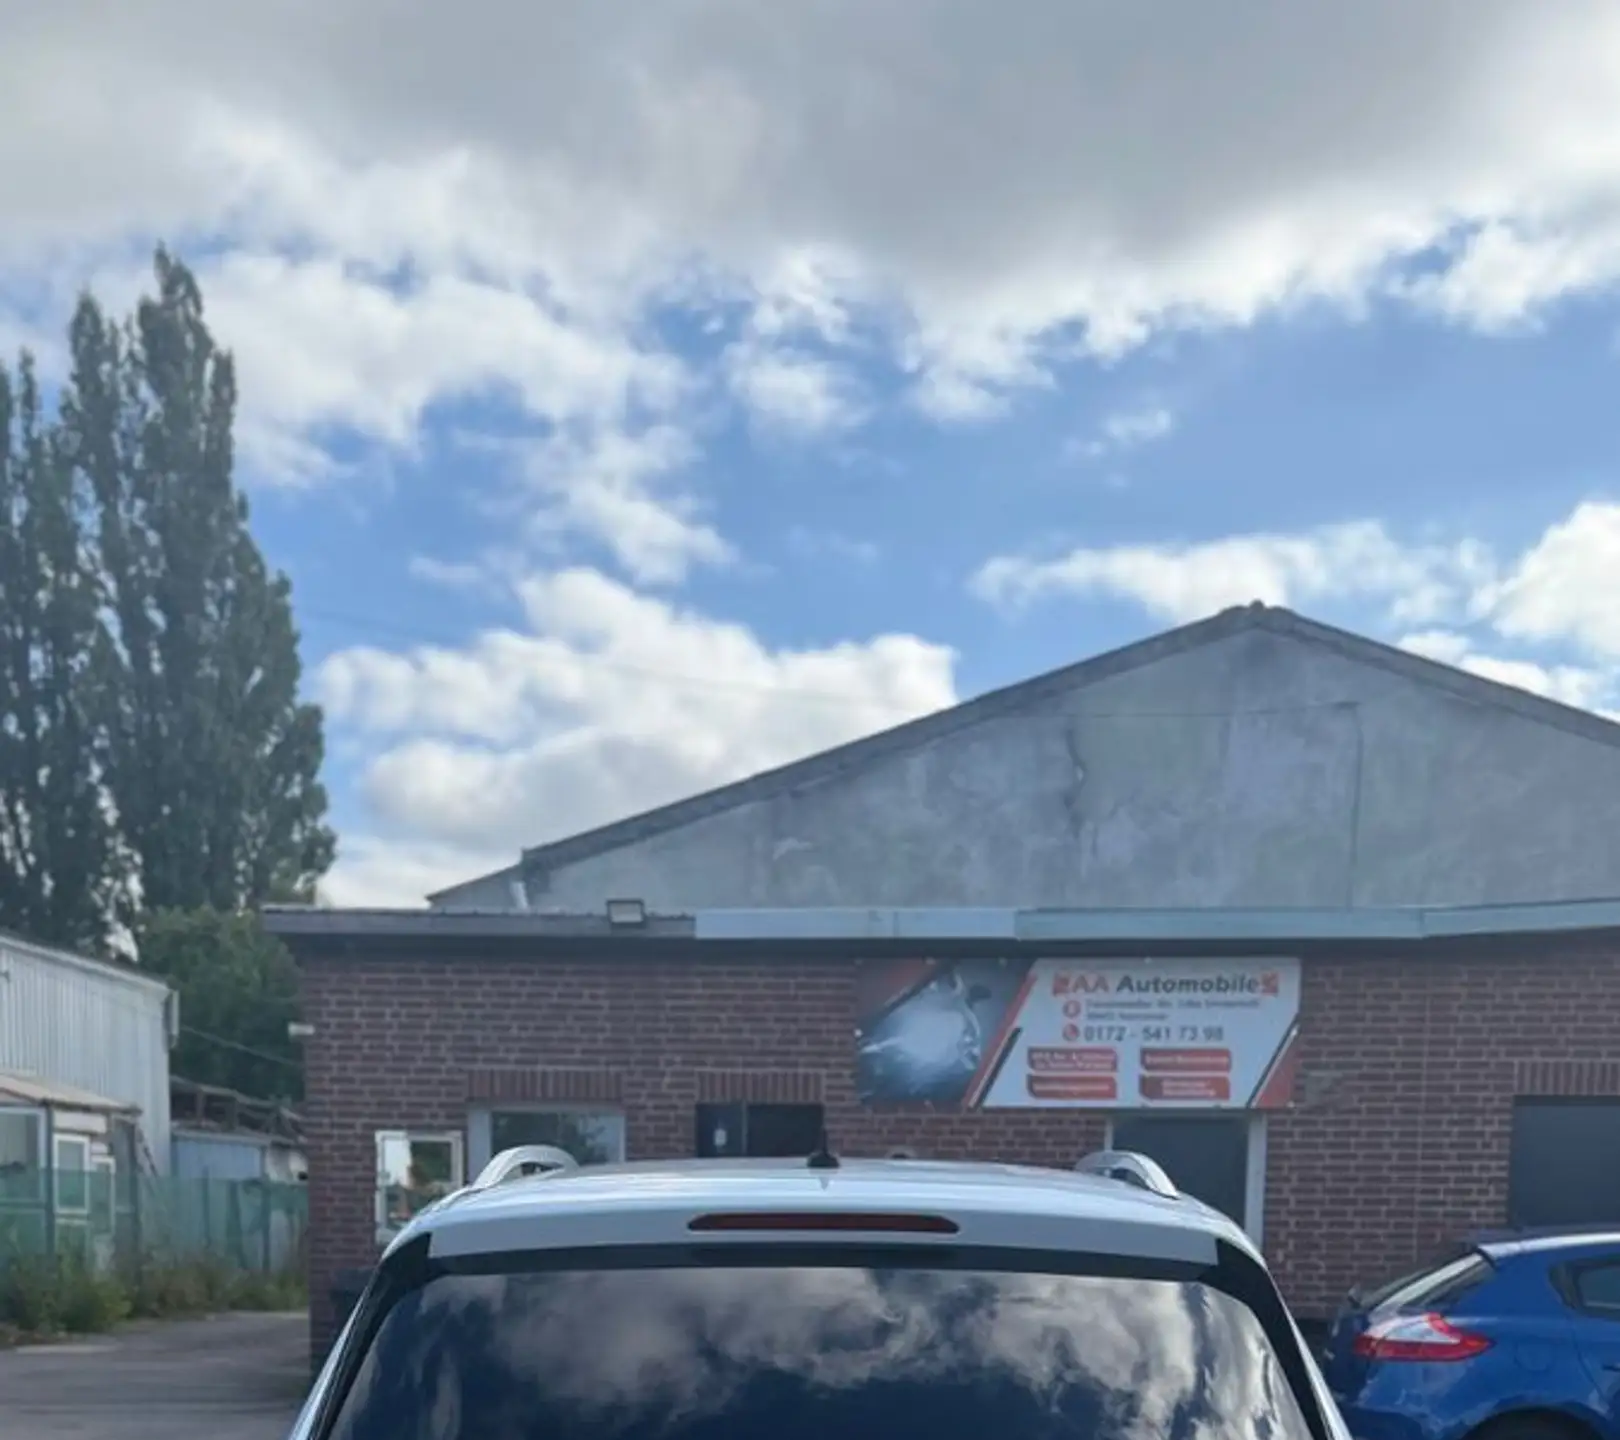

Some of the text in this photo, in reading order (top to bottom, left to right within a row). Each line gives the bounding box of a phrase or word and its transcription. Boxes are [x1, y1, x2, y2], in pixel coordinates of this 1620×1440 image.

[1070, 974, 1260, 995] AA Automobile
[1084, 1025, 1127, 1042] 0172
[1141, 1025, 1171, 1041] 541
[1179, 1026, 1198, 1041] 73
